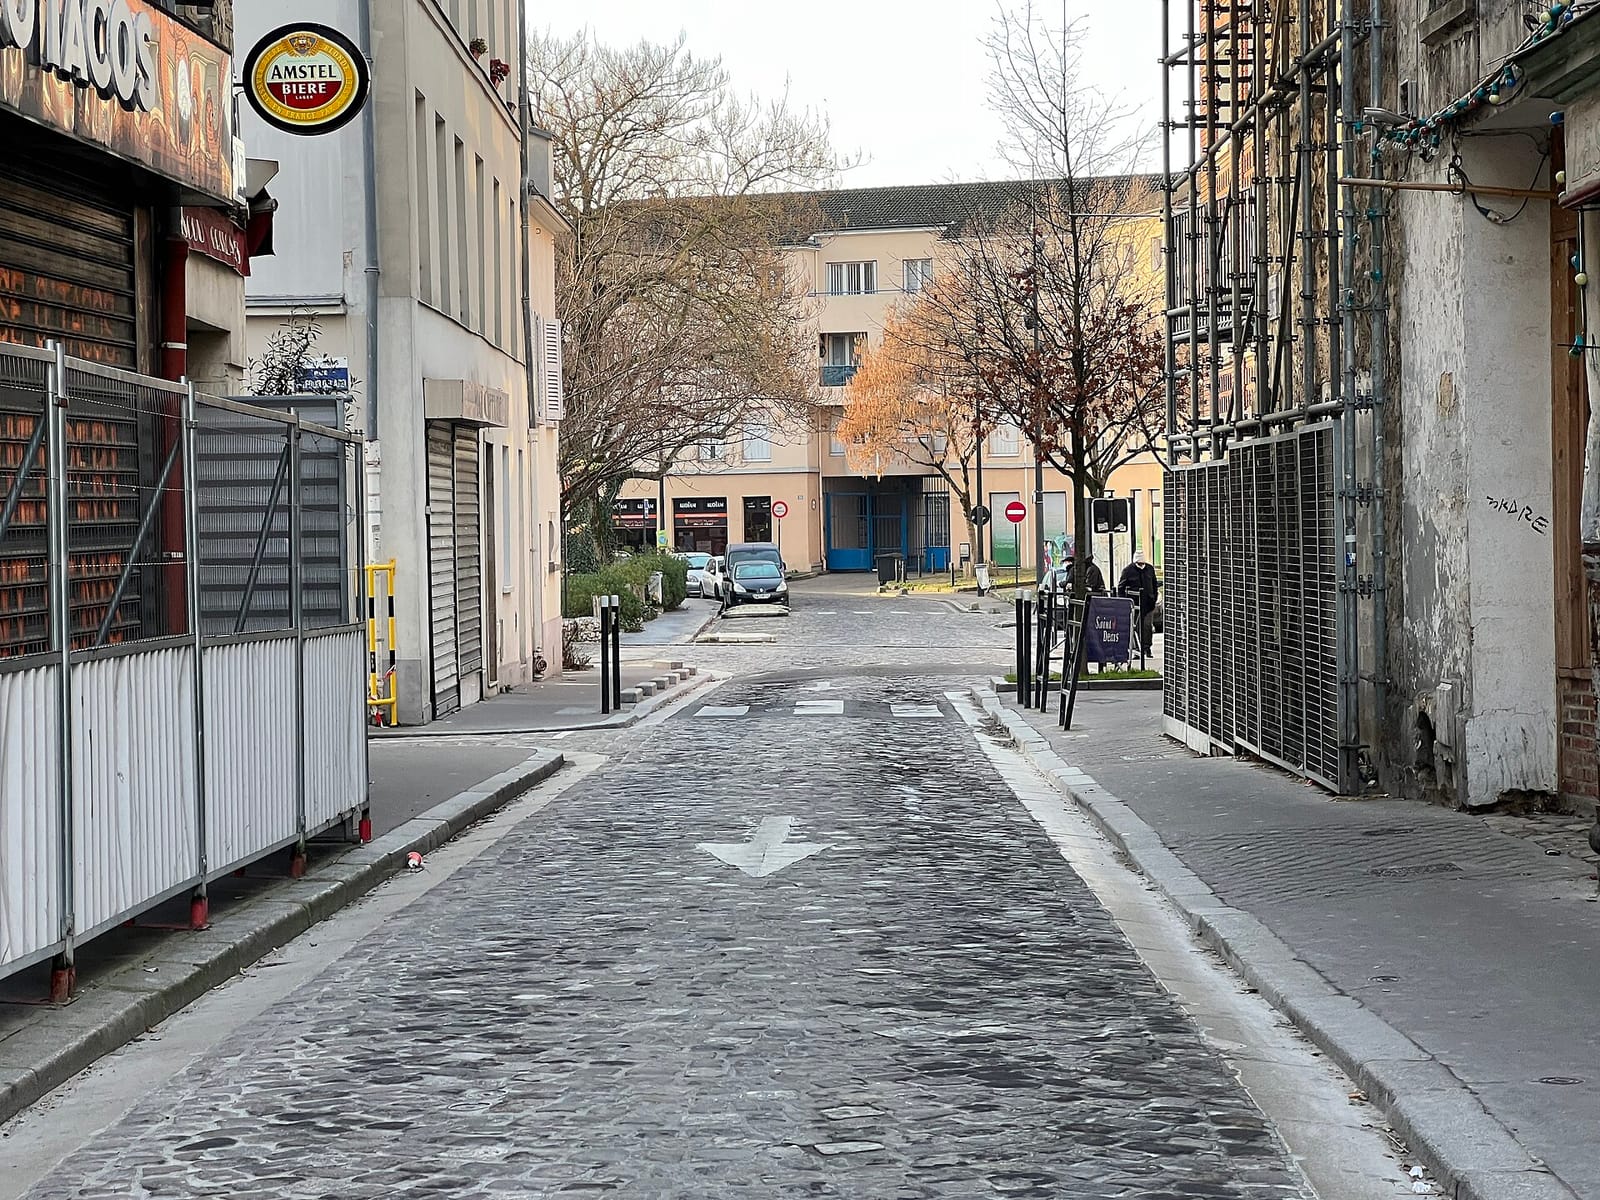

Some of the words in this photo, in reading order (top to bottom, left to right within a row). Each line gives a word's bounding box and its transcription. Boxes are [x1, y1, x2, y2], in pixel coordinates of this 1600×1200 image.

[271, 65, 337, 80] AMSTEL
[282, 83, 327, 95] BIERE
[1095, 616, 1112, 629] Saint
